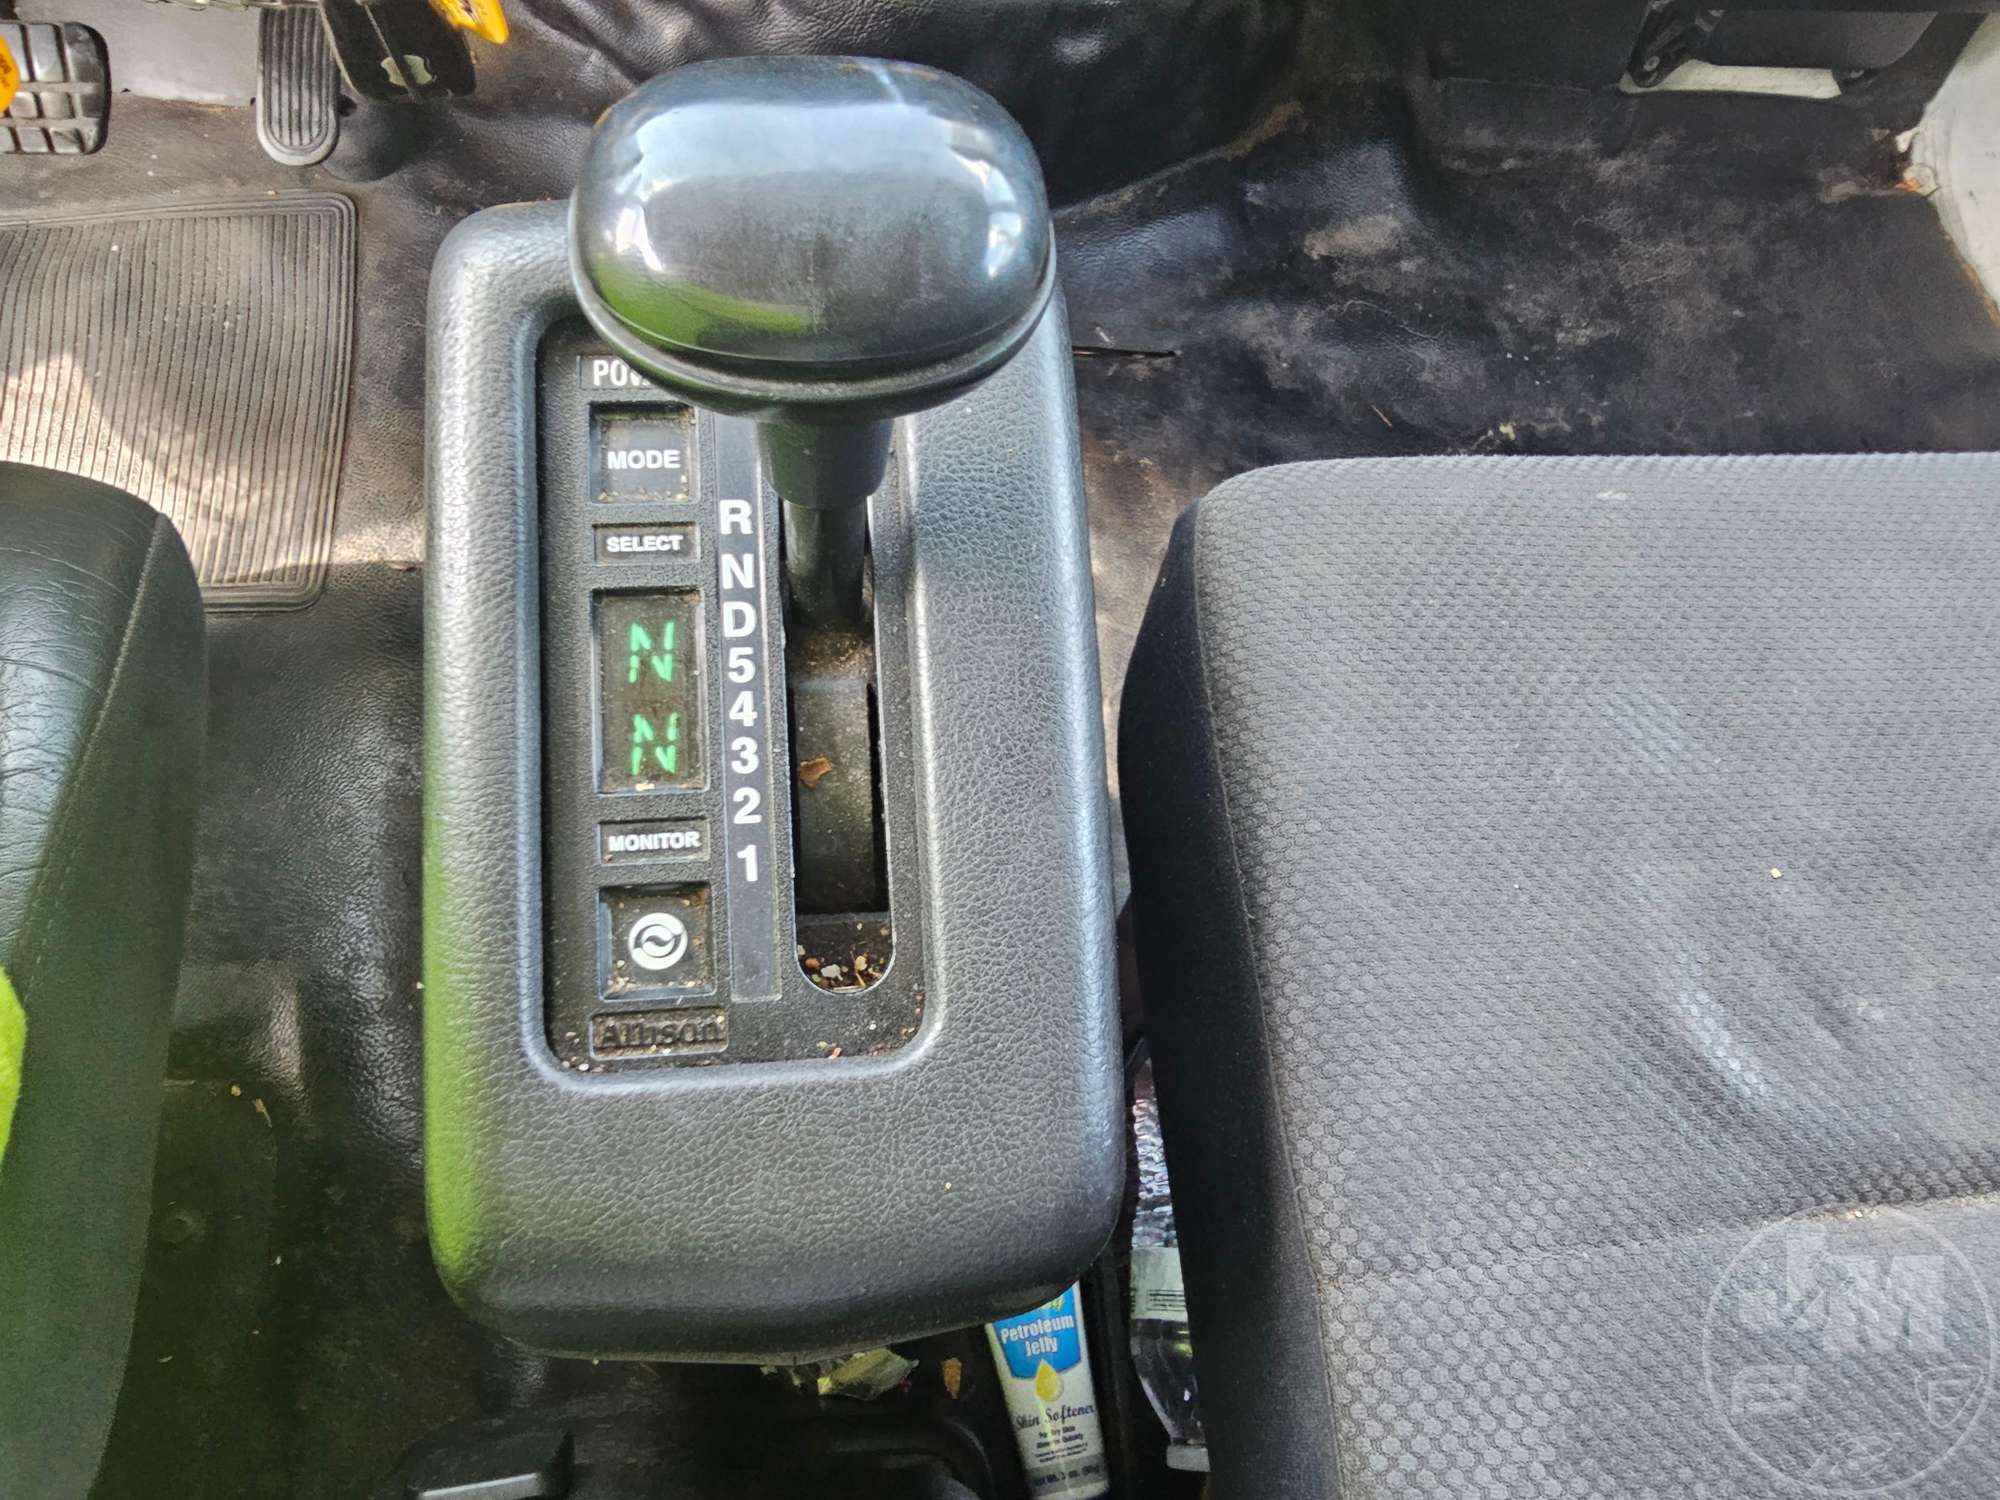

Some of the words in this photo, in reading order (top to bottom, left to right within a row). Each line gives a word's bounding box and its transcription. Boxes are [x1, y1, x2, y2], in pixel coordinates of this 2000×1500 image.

[607, 450, 681, 469] MODE
[719, 500, 754, 534] R
[606, 534, 684, 552] SELECT
[721, 553, 755, 590] N
[723, 601, 757, 638] D
[627, 620, 676, 683] N
[728, 647, 756, 683] 5
[728, 691, 758, 727] 4
[632, 711, 679, 776] N
[731, 737, 759, 774] 3
[733, 788, 762, 825] 2
[608, 831, 701, 851] MONITOR
[737, 845, 758, 882] 1
[1000, 1314, 1075, 1345] Petroleum
[1025, 1335, 1058, 1357] Jelly
[1016, 1411, 1040, 1428] Skin
[1045, 1404, 1095, 1424] Softener
